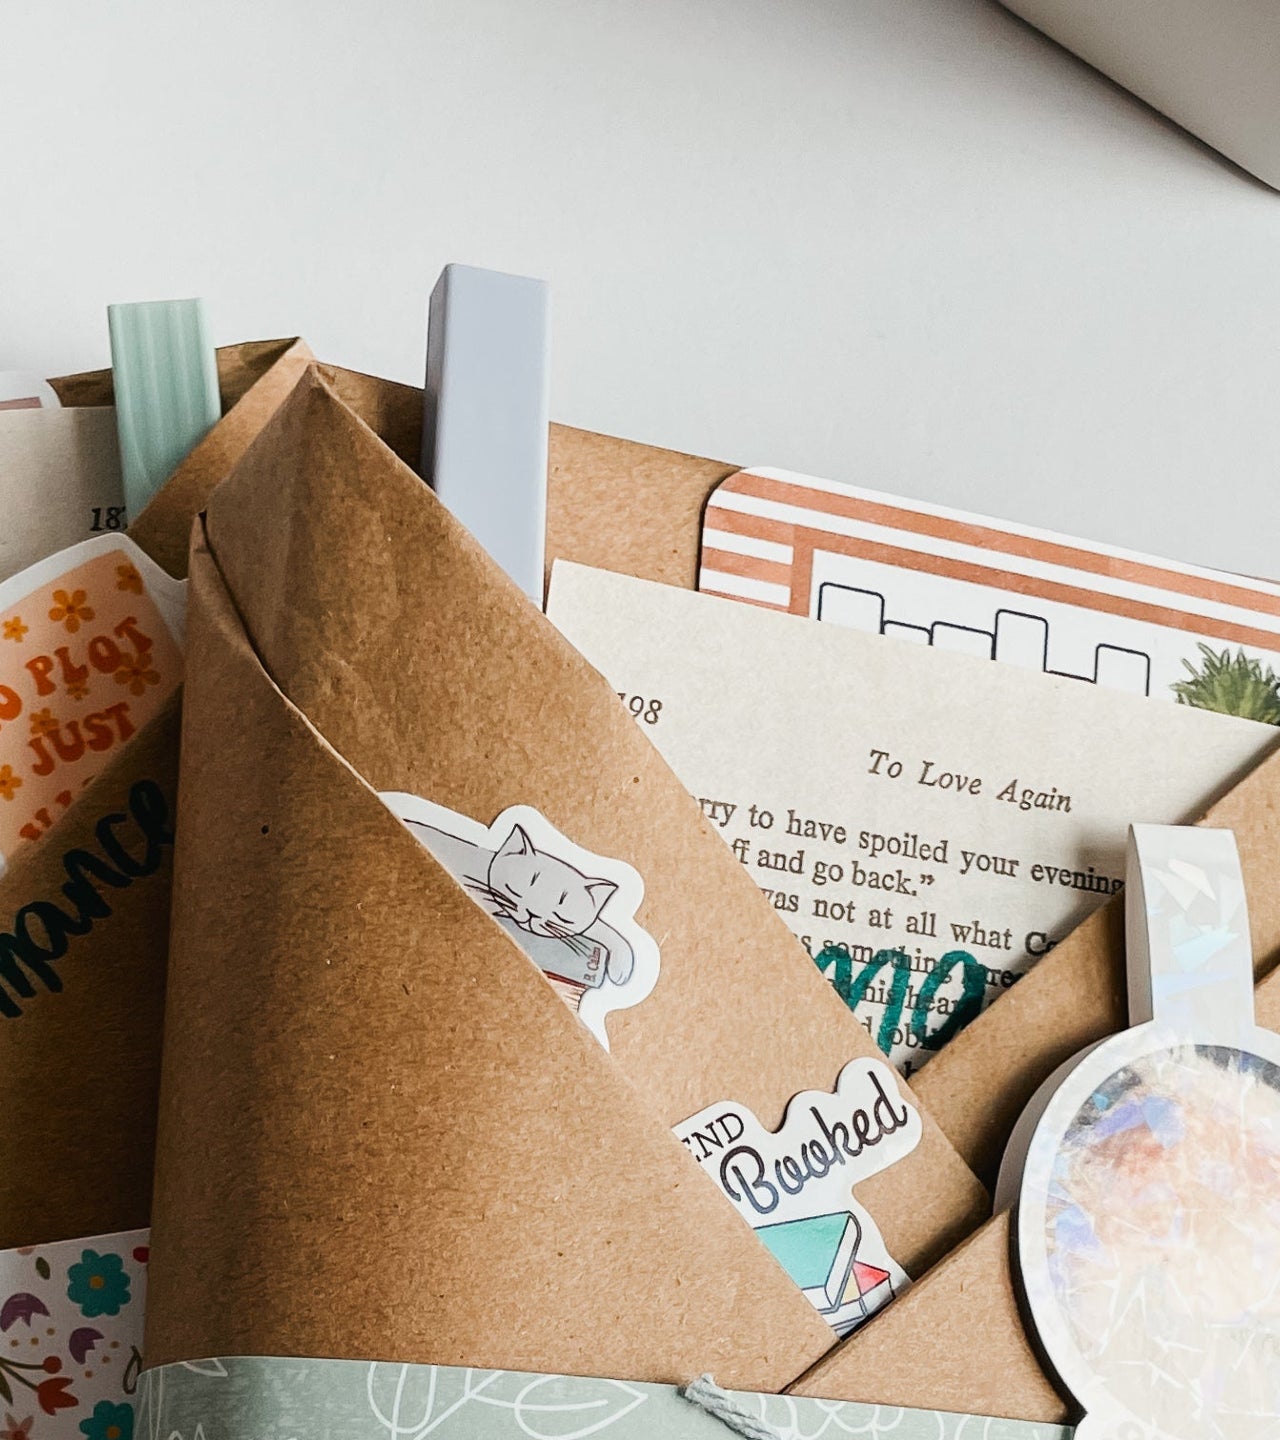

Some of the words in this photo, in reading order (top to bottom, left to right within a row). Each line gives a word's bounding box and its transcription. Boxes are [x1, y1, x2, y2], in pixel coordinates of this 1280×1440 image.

[25, 616, 154, 697] PLOT
[28, 702, 137, 776] JUST
[618, 693, 663, 724] 98
[868, 749, 902, 778] To
[918, 760, 982, 794] Love
[996, 779, 1072, 813] Again
[748, 804, 774, 829] to
[785, 809, 847, 844] have
[858, 829, 949, 864] spoiled
[960, 849, 1020, 875] your
[757, 849, 805, 875] and
[812, 860, 844, 886] go
[851, 860, 936, 897] back.”
[812, 899, 856, 924] not
[868, 909, 894, 930] at
[906, 909, 938, 938] all
[950, 920, 1013, 951] what
[720, 1070, 908, 1214] Booked
